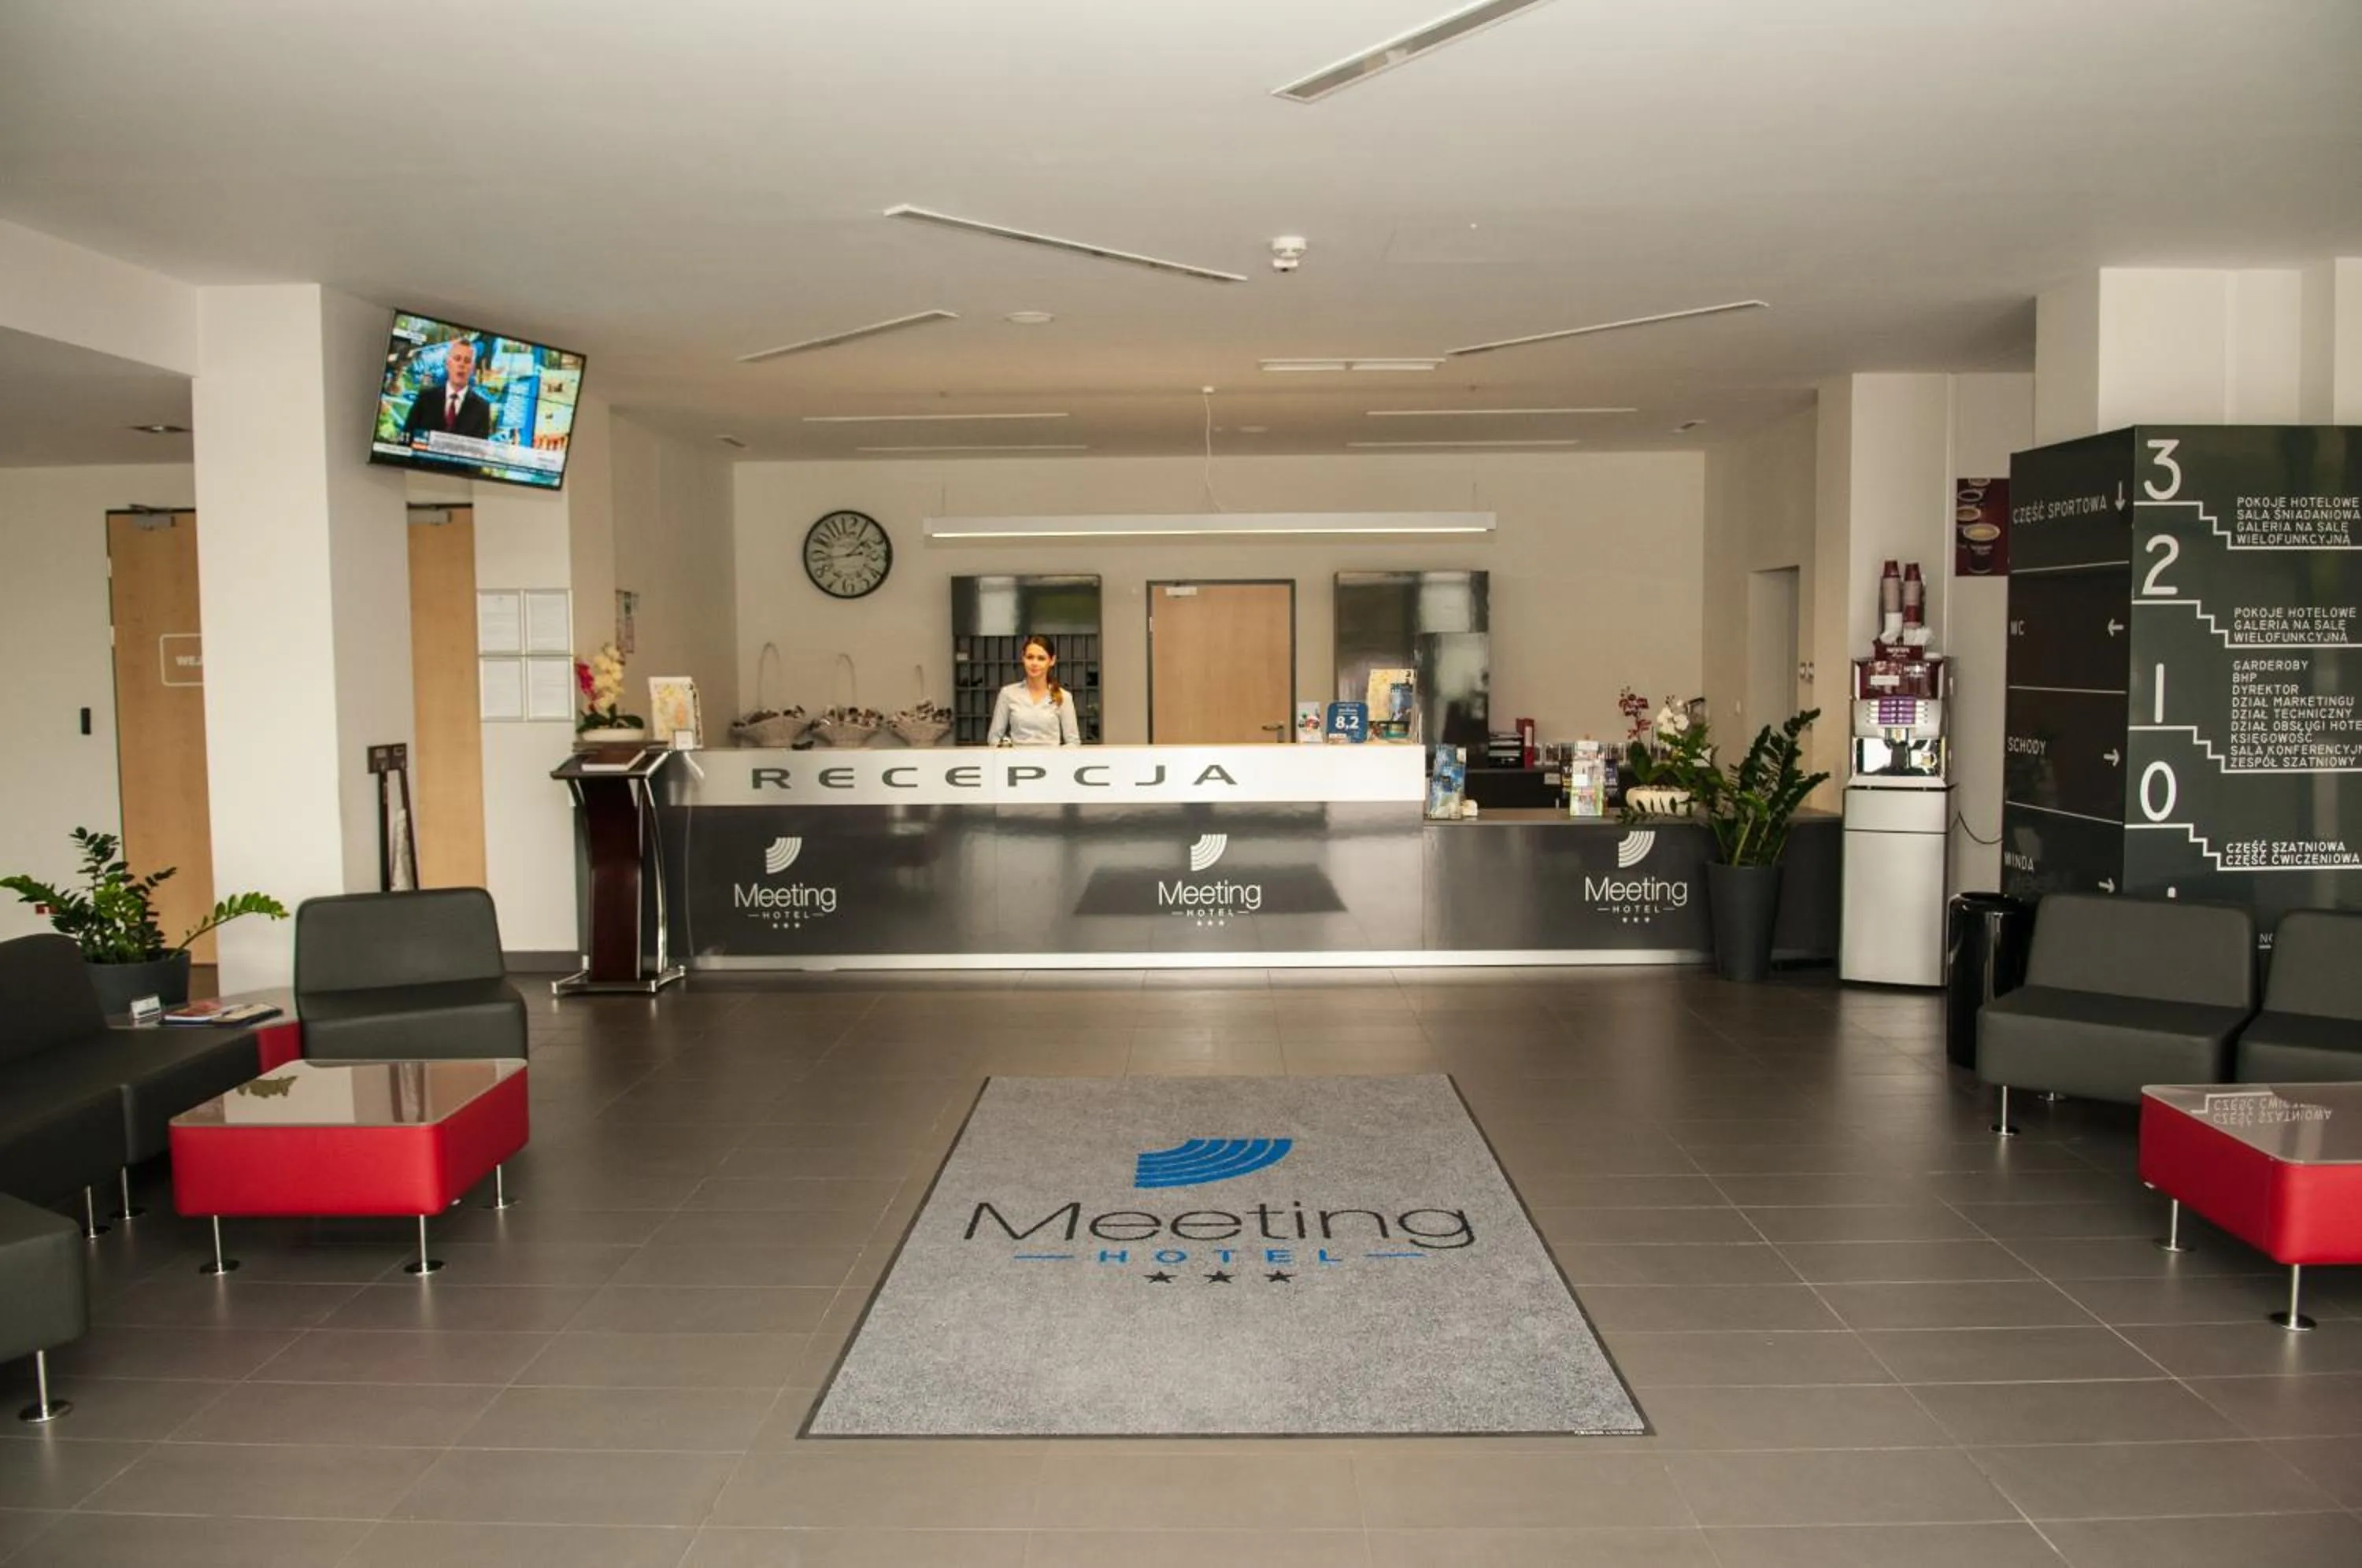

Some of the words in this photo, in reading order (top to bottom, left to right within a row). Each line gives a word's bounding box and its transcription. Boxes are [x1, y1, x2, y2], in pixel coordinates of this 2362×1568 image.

[2144, 438, 2182, 501] 3
[2048, 494, 2108, 519] SPORTOWA
[2237, 497, 2286, 508] POKOJE
[2290, 497, 2360, 508] HOTELOWE
[2237, 509, 2270, 520] SALA
[2274, 507, 2361, 520] ŚNIADANIOWA
[2237, 522, 2292, 532] GALERIA
[2295, 522, 2312, 532] NA
[2142, 534, 2180, 596] 2
[2234, 607, 2283, 618] POKOJE
[2287, 607, 2356, 618] HOTELOWE
[2234, 619, 2289, 630] GALERIA
[2293, 619, 2310, 630] NA
[2233, 660, 2308, 671] GARDEROBY
[2232, 672, 2257, 682] BHP
[2232, 684, 2299, 695] DYREKTOR
[2232, 697, 2268, 707] DZIAŁ
[2273, 696, 2355, 707] MARKETINGU
[2231, 709, 2268, 719] DZIAŁ
[2274, 708, 2353, 719] TECHNICZNY
[1335, 716, 1359, 730] 8,2
[2231, 721, 2268, 731] DZIAŁ
[2273, 720, 2326, 731] OBSŁUGI
[2231, 730, 2313, 745] KSIĘGOWOŚĆ
[2008, 737, 2046, 755] SCHODY
[2231, 745, 2264, 756] SALA
[2230, 755, 2278, 767] ZESPÓŁ
[2283, 756, 2356, 767] SZATNIOWY
[751, 764, 1238, 789] RECEPCJA
[2139, 760, 2177, 822] 0
[2226, 840, 2267, 855] CZĘŚĆ
[2271, 841, 2345, 852] SZATNIOWA
[2004, 852, 2035, 871] WINDA
[2226, 852, 2267, 866] CZĘŚĆ
[2271, 852, 2360, 865] ĆWICZENIOWA
[734, 882, 837, 912] Meeting
[1158, 879, 1261, 909] Meeting
[1585, 875, 1688, 907] Meeting
[762, 911, 809, 919] HOTEL
[1187, 908, 1235, 918] HOTEL
[1612, 905, 1660, 914] HOTEL
[962, 1200, 1478, 1250] Meeting
[1098, 1249, 1343, 1264] HOTEL
